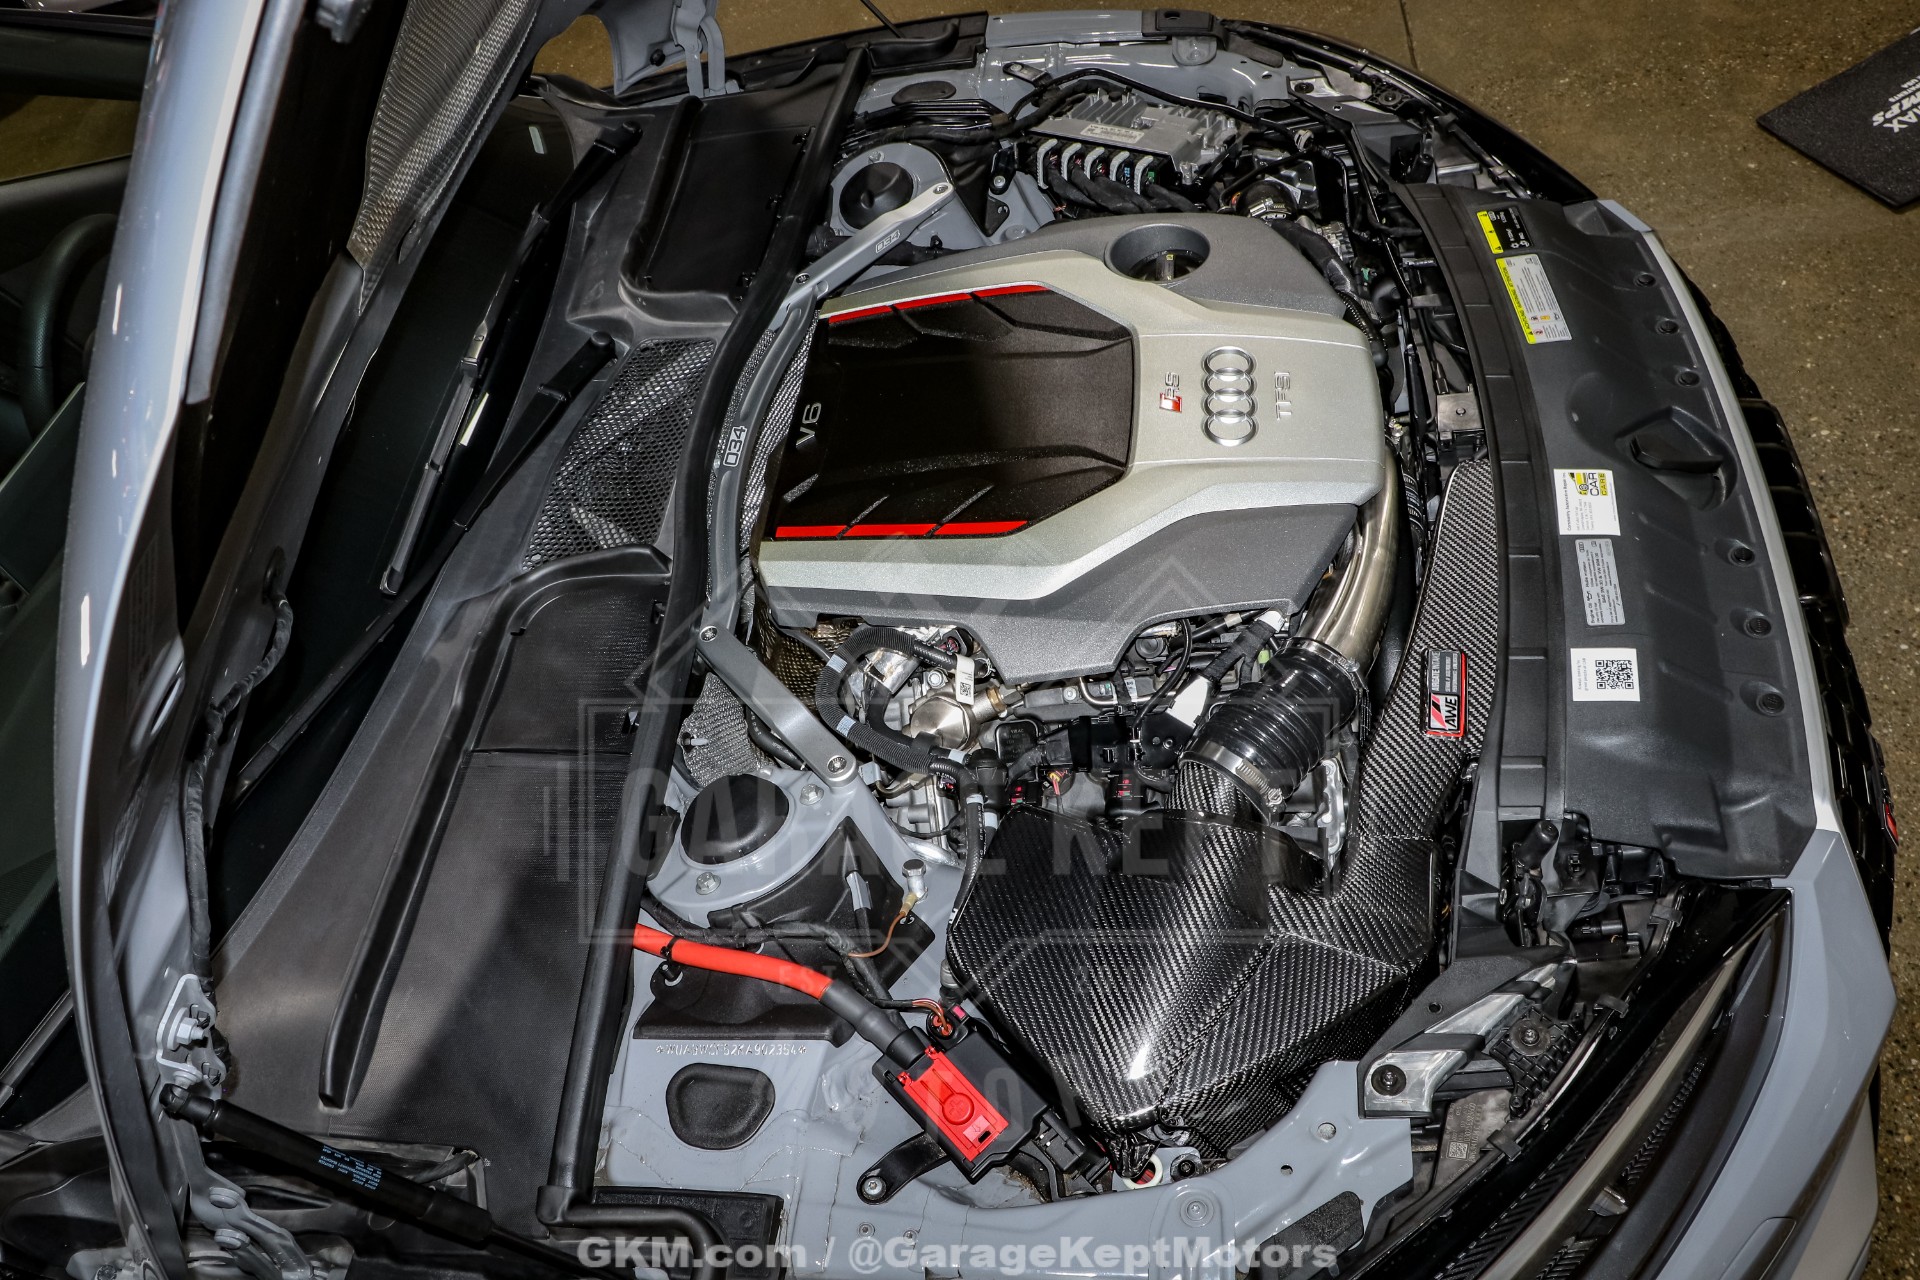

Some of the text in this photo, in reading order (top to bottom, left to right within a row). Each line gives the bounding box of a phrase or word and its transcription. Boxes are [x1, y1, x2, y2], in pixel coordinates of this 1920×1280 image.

[1274, 371, 1292, 421] TFSI
[796, 402, 822, 450] V6
[723, 425, 748, 467] 034
[1588, 473, 1599, 496] CAR
[1599, 473, 1607, 495] CARE
[1445, 697, 1457, 728] AWE
